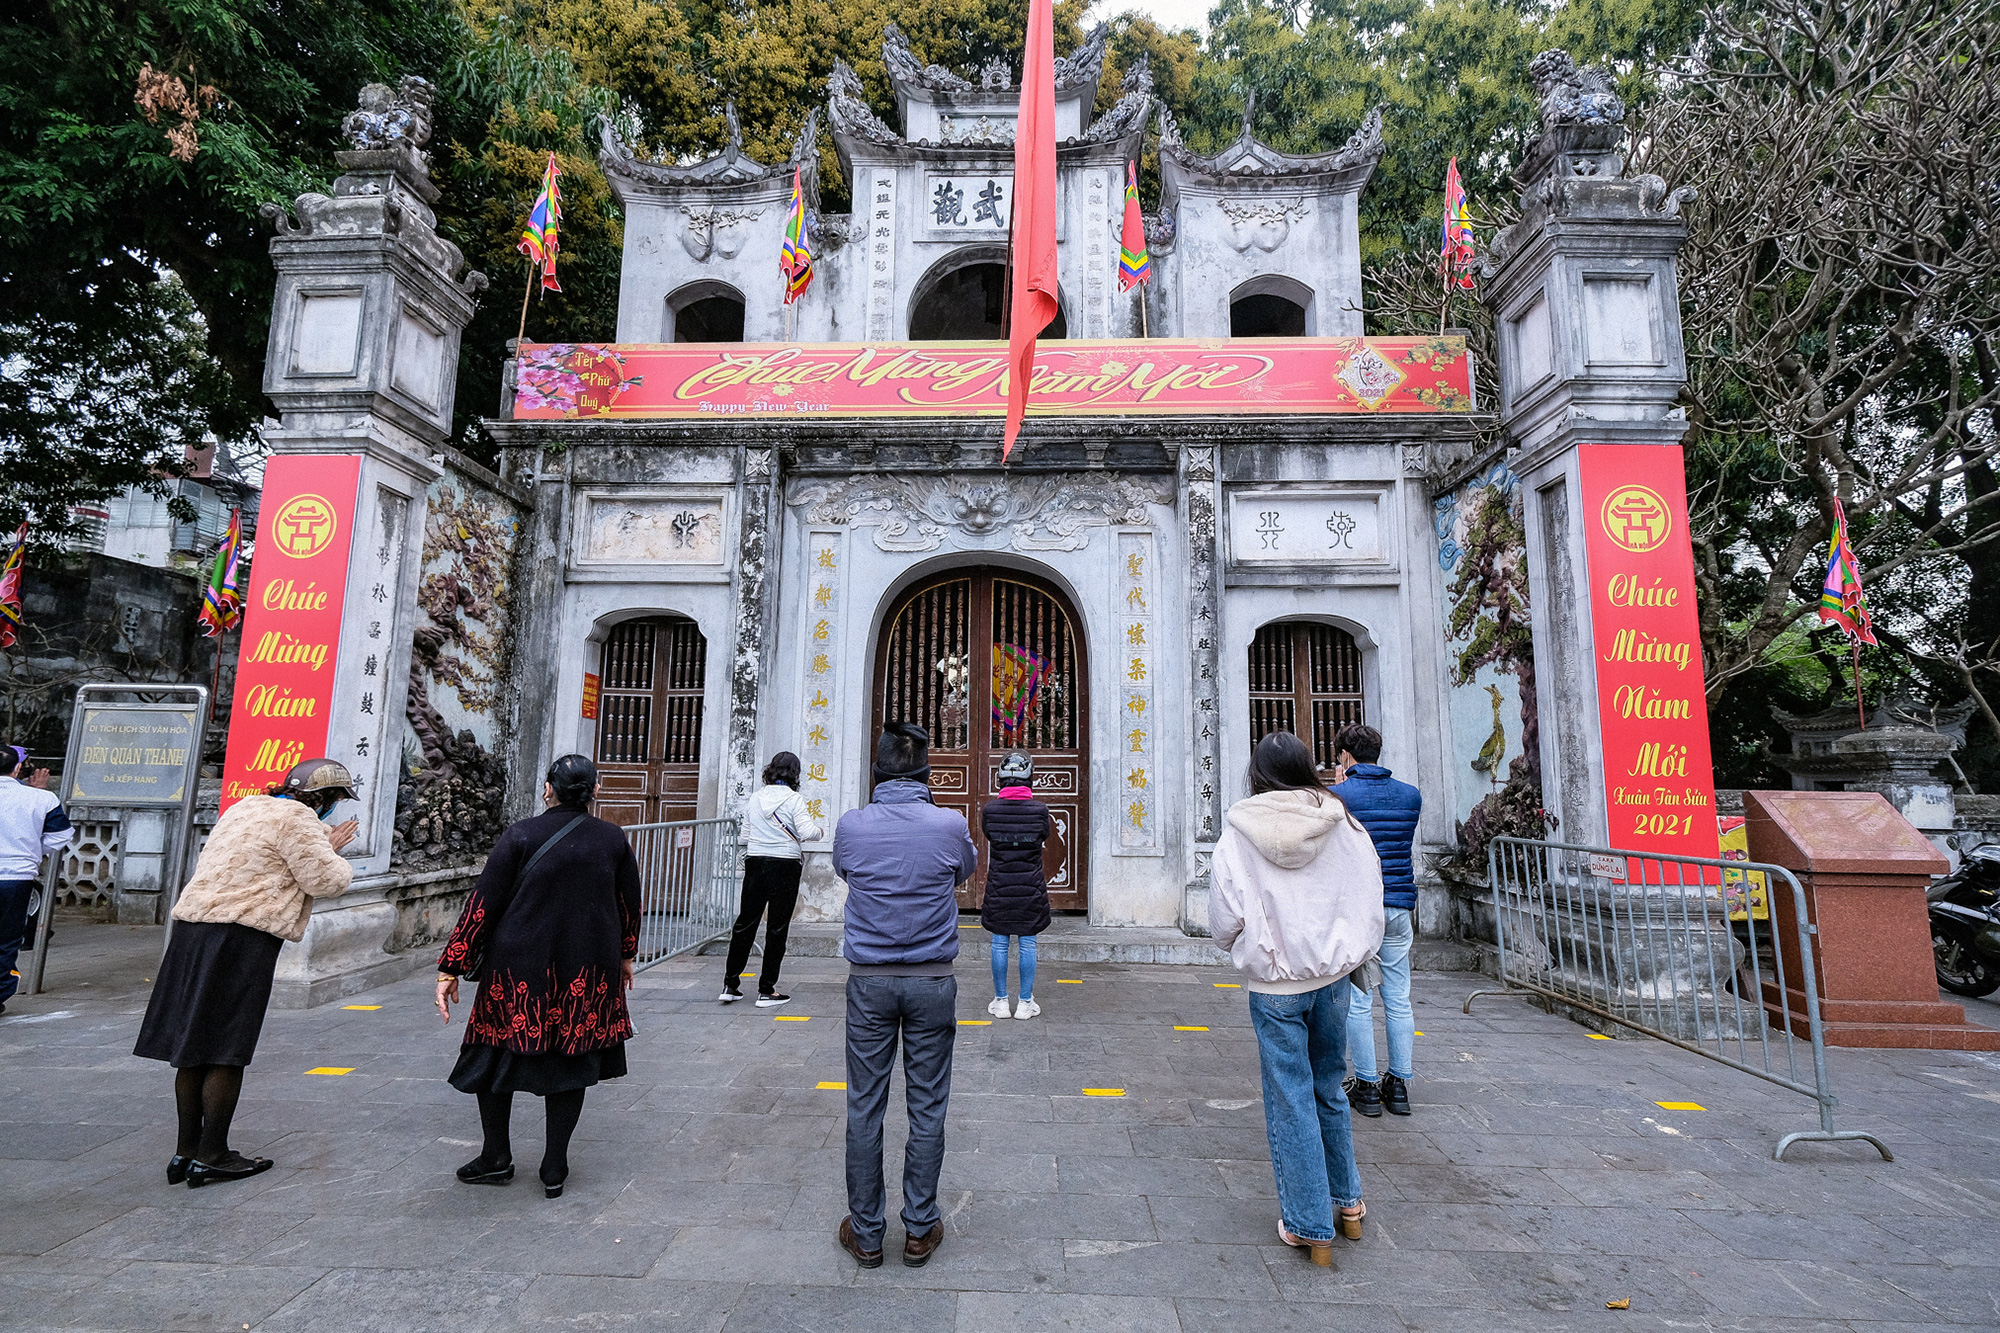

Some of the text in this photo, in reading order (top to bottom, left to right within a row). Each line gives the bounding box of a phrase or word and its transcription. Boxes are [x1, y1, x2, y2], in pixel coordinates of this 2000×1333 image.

[930, 179, 1005, 228] 武觀
[575, 351, 595, 369] Tết
[674, 347, 840, 399] Chúc
[823, 347, 1004, 391] Mừng
[1117, 354, 1275, 403] Mới
[590, 372, 610, 386] Phú
[1358, 388, 1386, 397] 2021
[580, 394, 598, 410] Quý
[698, 401, 830, 414] Happy New Year
[263, 579, 328, 611] Chúc
[1608, 573, 1679, 607] Chúc
[246, 631, 328, 671] Mừng
[1604, 628, 1693, 671] Mừng
[245, 684, 317, 717] Năm
[1613, 684, 1692, 719] Năm
[83, 737, 185, 766] ĐỀN QUÁN THÁNH
[246, 738, 305, 772] Mới
[1627, 742, 1689, 777] Mới
[1613, 786, 1651, 806] Xuân
[1654, 787, 1681, 806] Tân
[1633, 813, 1693, 836] 2021
